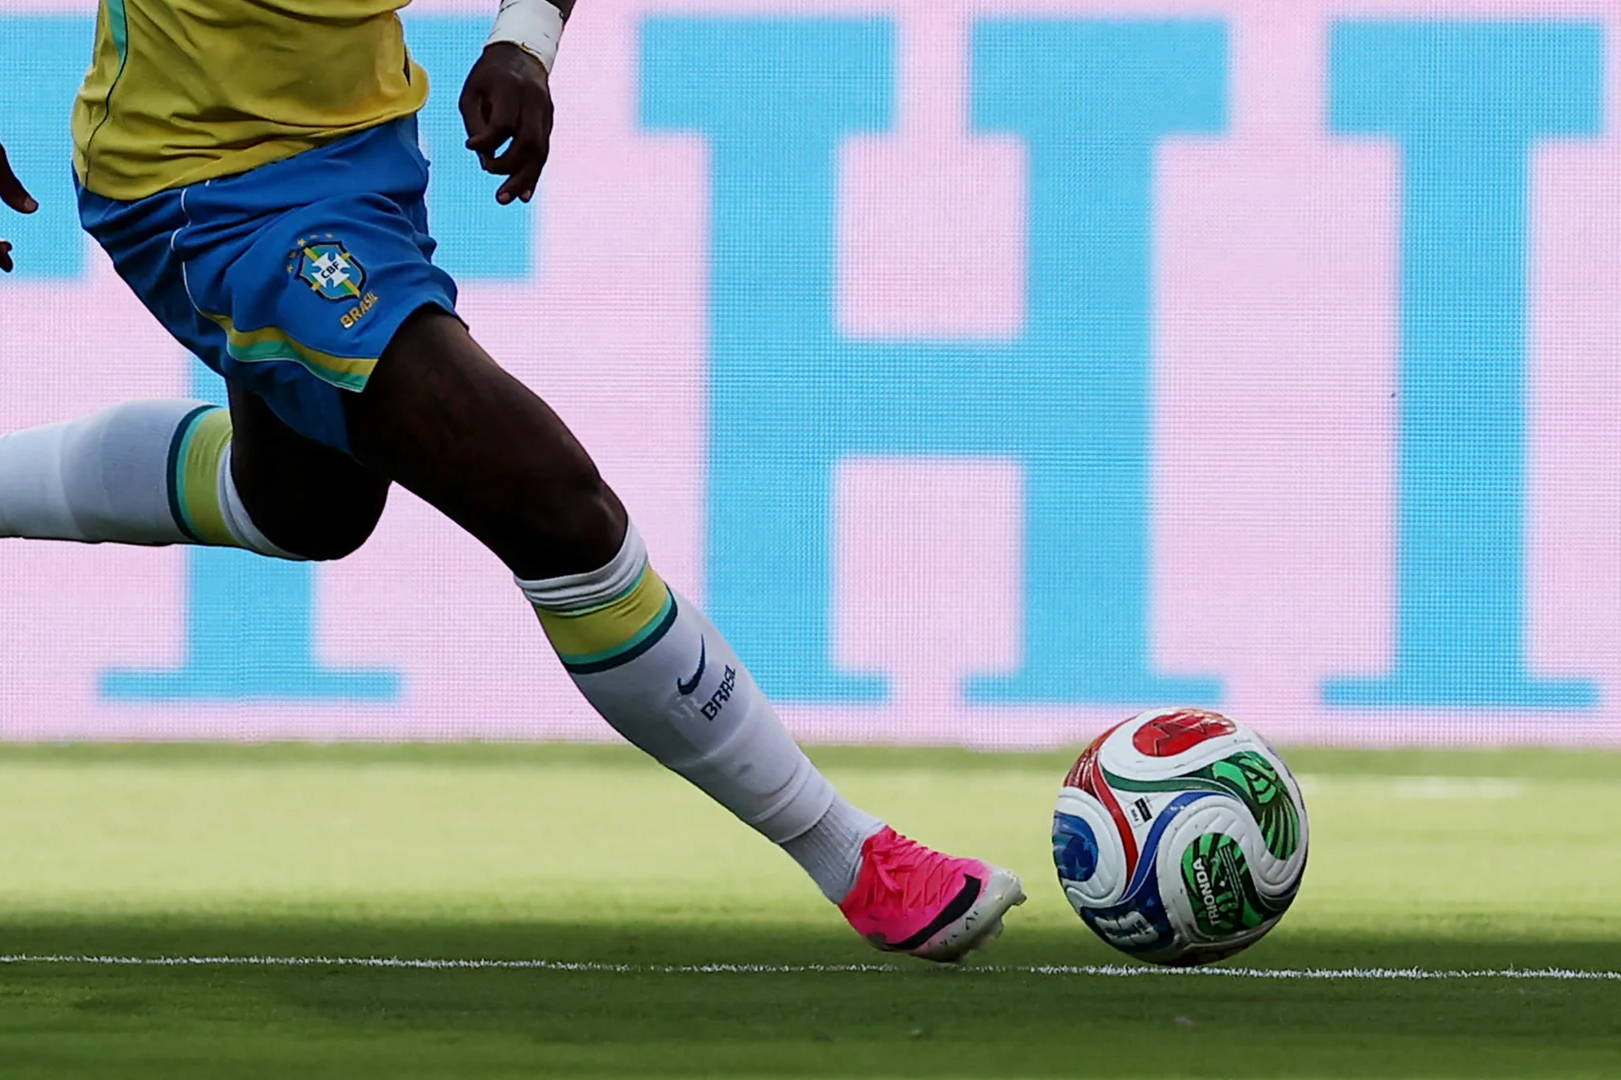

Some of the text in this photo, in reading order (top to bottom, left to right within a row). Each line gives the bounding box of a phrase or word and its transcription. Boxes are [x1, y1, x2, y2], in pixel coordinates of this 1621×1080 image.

[320, 261, 340, 279] CBF
[340, 291, 378, 329] BRASIL
[700, 664, 736, 722] BRASIL
[1192, 857, 1221, 927] TRIONDA
